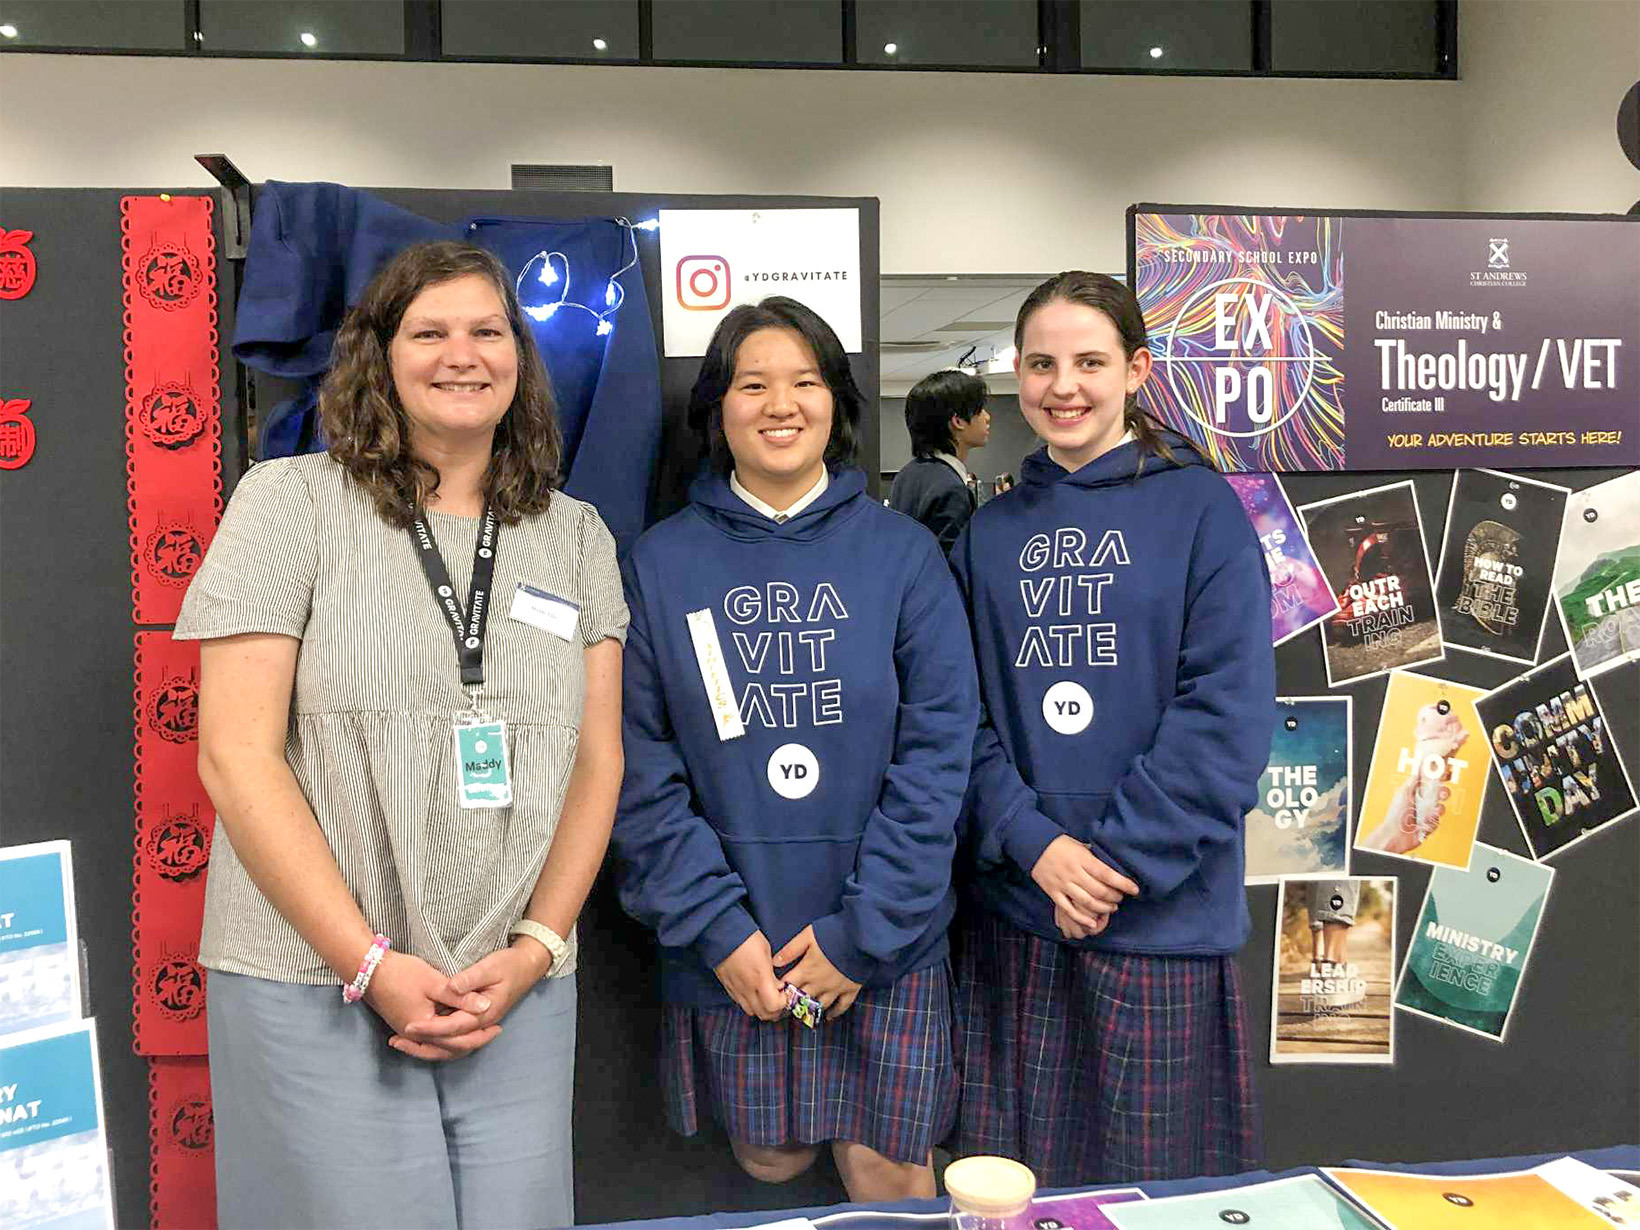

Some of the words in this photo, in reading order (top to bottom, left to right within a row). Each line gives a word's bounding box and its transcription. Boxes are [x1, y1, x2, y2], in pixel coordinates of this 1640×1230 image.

[1164, 250, 1232, 263] SECONDARY
[1239, 251, 1282, 263] SCHOOL
[1288, 251, 1318, 264] EXPO
[744, 271, 848, 282] @YDGRAVITATE
[1470, 272, 1481, 280] ST
[1483, 272, 1527, 280] ANDREWS
[1375, 310, 1432, 330] Christian
[1435, 310, 1489, 334] Ministry
[1492, 311, 1502, 330] &
[1374, 339, 1528, 401] Theology
[1556, 338, 1622, 389] VET
[1382, 397, 1432, 412] Certificate
[1434, 397, 1445, 411] III
[1387, 433, 1423, 449] YOUR
[1426, 432, 1513, 448] ADVENTURE
[1518, 431, 1576, 445] STARTS
[1581, 430, 1622, 444] HERE!
[482, 506, 495, 547] GRAVITA
[1260, 529, 1287, 550] TS
[1019, 528, 1130, 572] GRA
[1474, 557, 1505, 573] HOW
[1507, 564, 1524, 577] TO
[1480, 570, 1513, 585] READ
[1020, 573, 1114, 617] VIT
[1350, 575, 1401, 601] OUTR
[1585, 578, 1640, 618] THE
[469, 589, 485, 635] GRAVITATE
[724, 582, 849, 625] GRA
[1352, 591, 1404, 617] EACH
[1457, 596, 1520, 625] BIBLE
[445, 598, 465, 641] GRAVITA
[1346, 604, 1415, 637] TRAIN
[732, 629, 835, 674] VIT
[1015, 623, 1118, 668] ATE
[1363, 627, 1402, 652] ING
[739, 679, 843, 728] ATE
[1054, 701, 1081, 715] YD
[465, 758, 502, 772] Maddy
[780, 764, 807, 779] YD
[1267, 765, 1317, 787] THE
[1397, 747, 1469, 785] HOT
[1266, 786, 1318, 808] OLO
[1534, 762, 1600, 827] DAY
[1274, 809, 1310, 829] GY
[0, 912, 15, 929] T
[1425, 921, 1519, 964] MINISTRY
[1310, 962, 1360, 978] LEAD
[1432, 941, 1500, 980] EXPER
[1300, 979, 1367, 994] ERSHIP
[1429, 961, 1493, 996] IENCE
